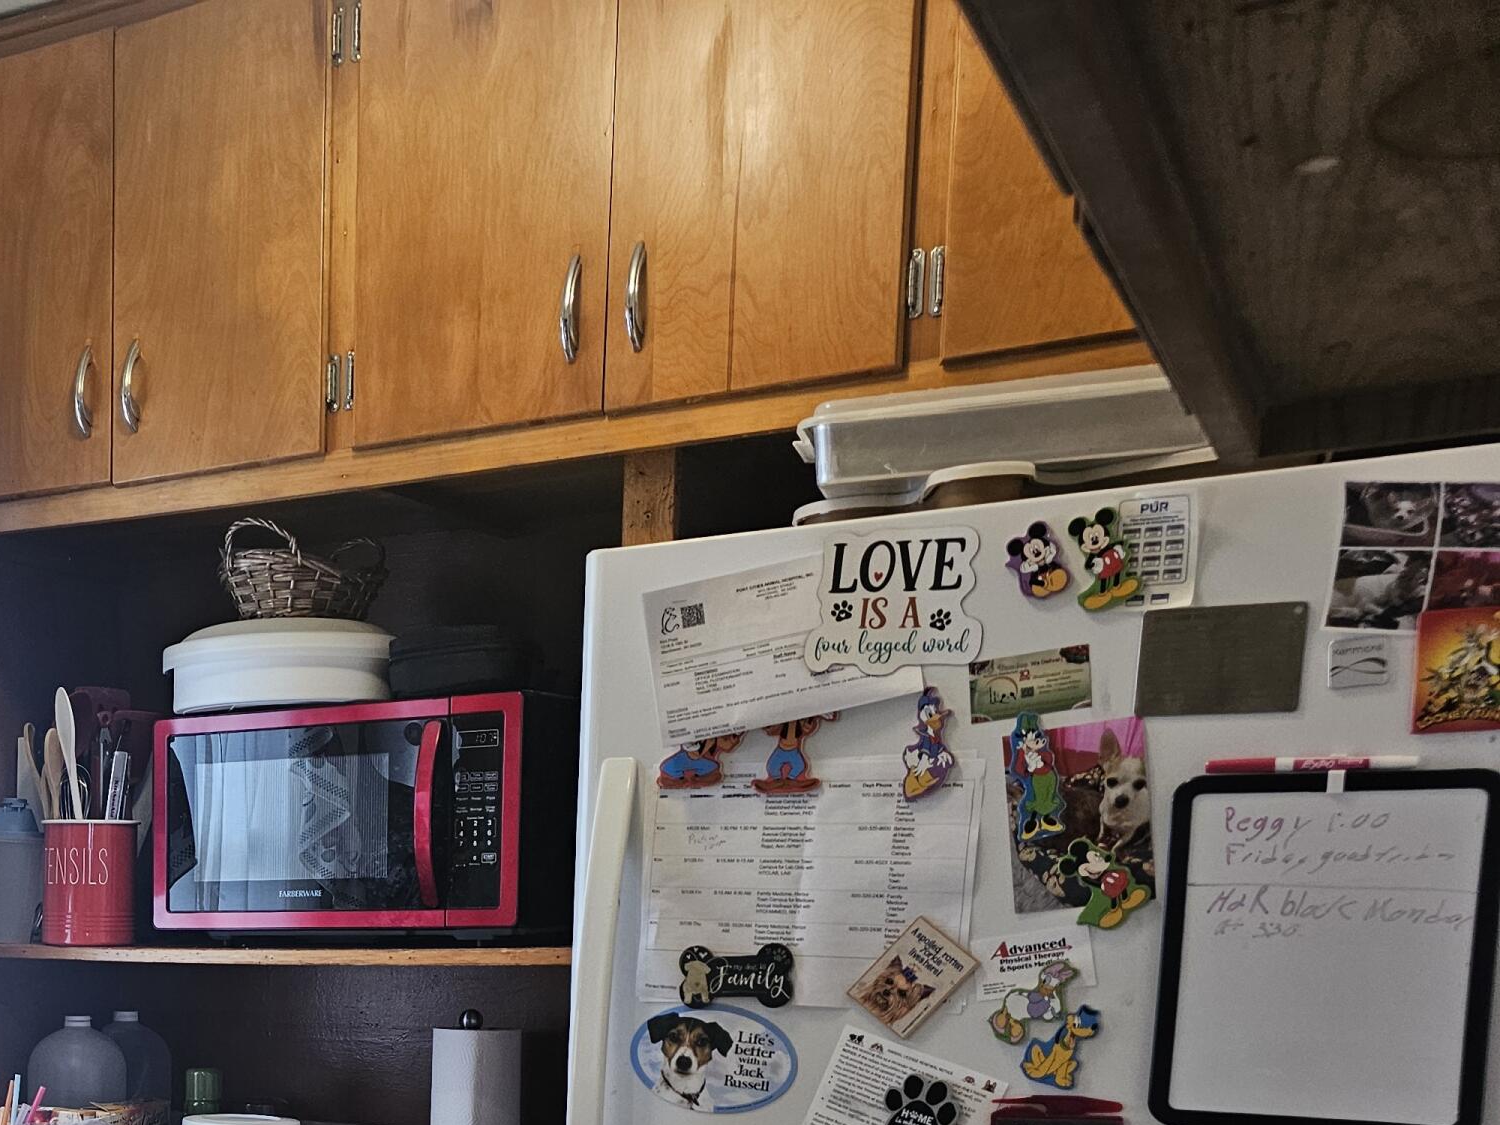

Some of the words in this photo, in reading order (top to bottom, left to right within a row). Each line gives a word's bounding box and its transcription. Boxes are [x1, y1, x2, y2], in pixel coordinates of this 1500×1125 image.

[829, 538, 966, 593] LOVE
[859, 597, 888, 629] IS
[899, 597, 922, 628] A
[815, 636, 850, 661] four
[858, 630, 918, 664] legged
[923, 628, 970, 653] word
[1225, 806, 1312, 849] Peggy
[279, 890, 322, 898] FARBERWARE
[916, 932, 944, 953] spoiled
[942, 952, 964, 972] rotten
[990, 937, 1067, 960] Advanced
[1000, 955, 1031, 965] Physical
[1034, 951, 1065, 961] Therapy
[1007, 963, 1033, 972] Sports
[710, 962, 790, 999] Family
[738, 1031, 774, 1046] Life's
[735, 1044, 775, 1058] better
[738, 1057, 760, 1066] with
[734, 1064, 764, 1078] Jack
[724, 1075, 769, 1092] Russell
